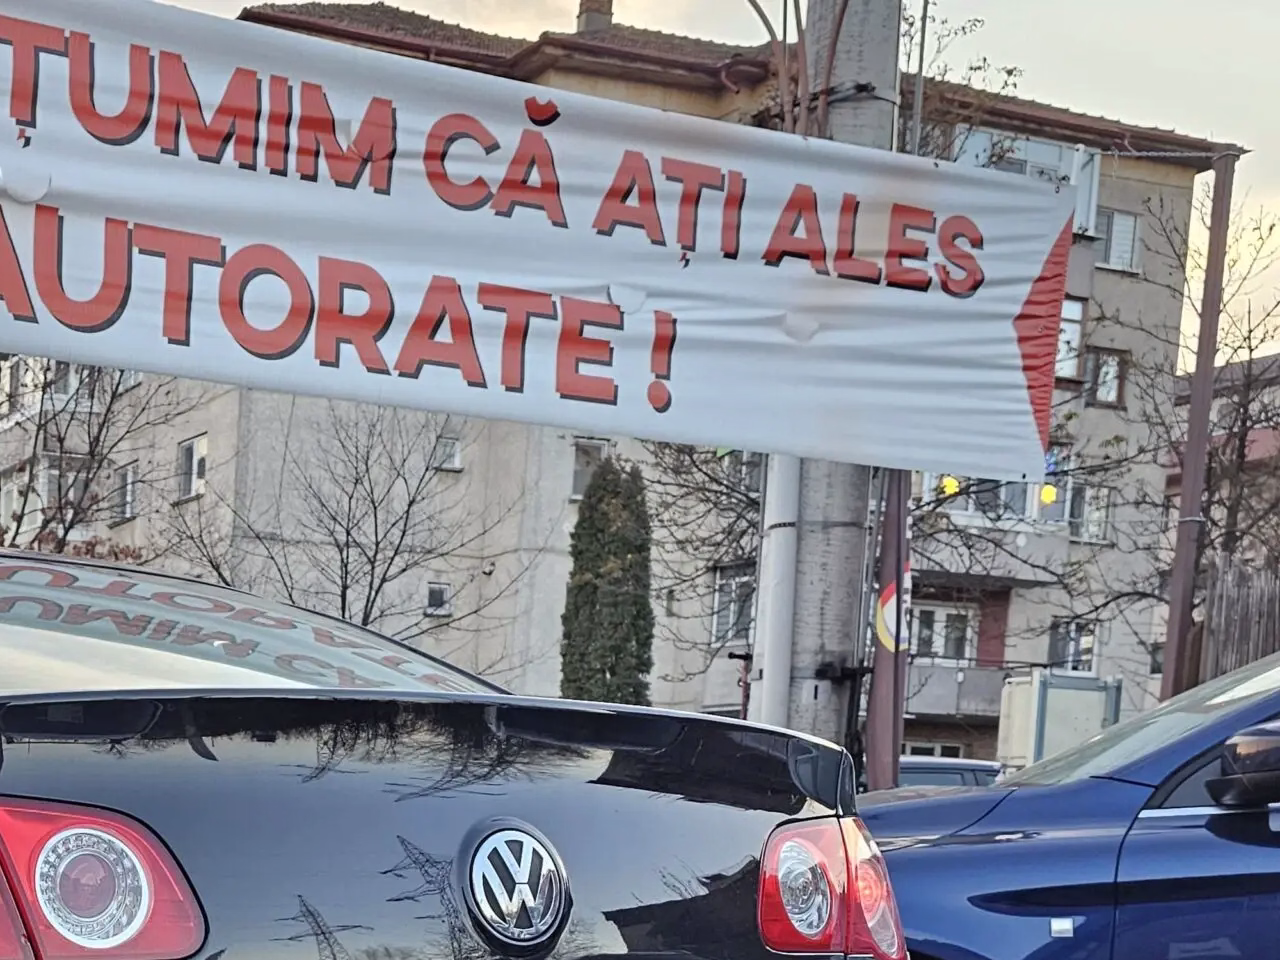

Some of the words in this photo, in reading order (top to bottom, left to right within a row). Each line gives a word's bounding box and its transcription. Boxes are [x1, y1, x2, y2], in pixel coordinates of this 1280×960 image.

[423, 96, 569, 228] CĂ
[591, 149, 747, 269] AȚI
[761, 183, 985, 299] ALES
